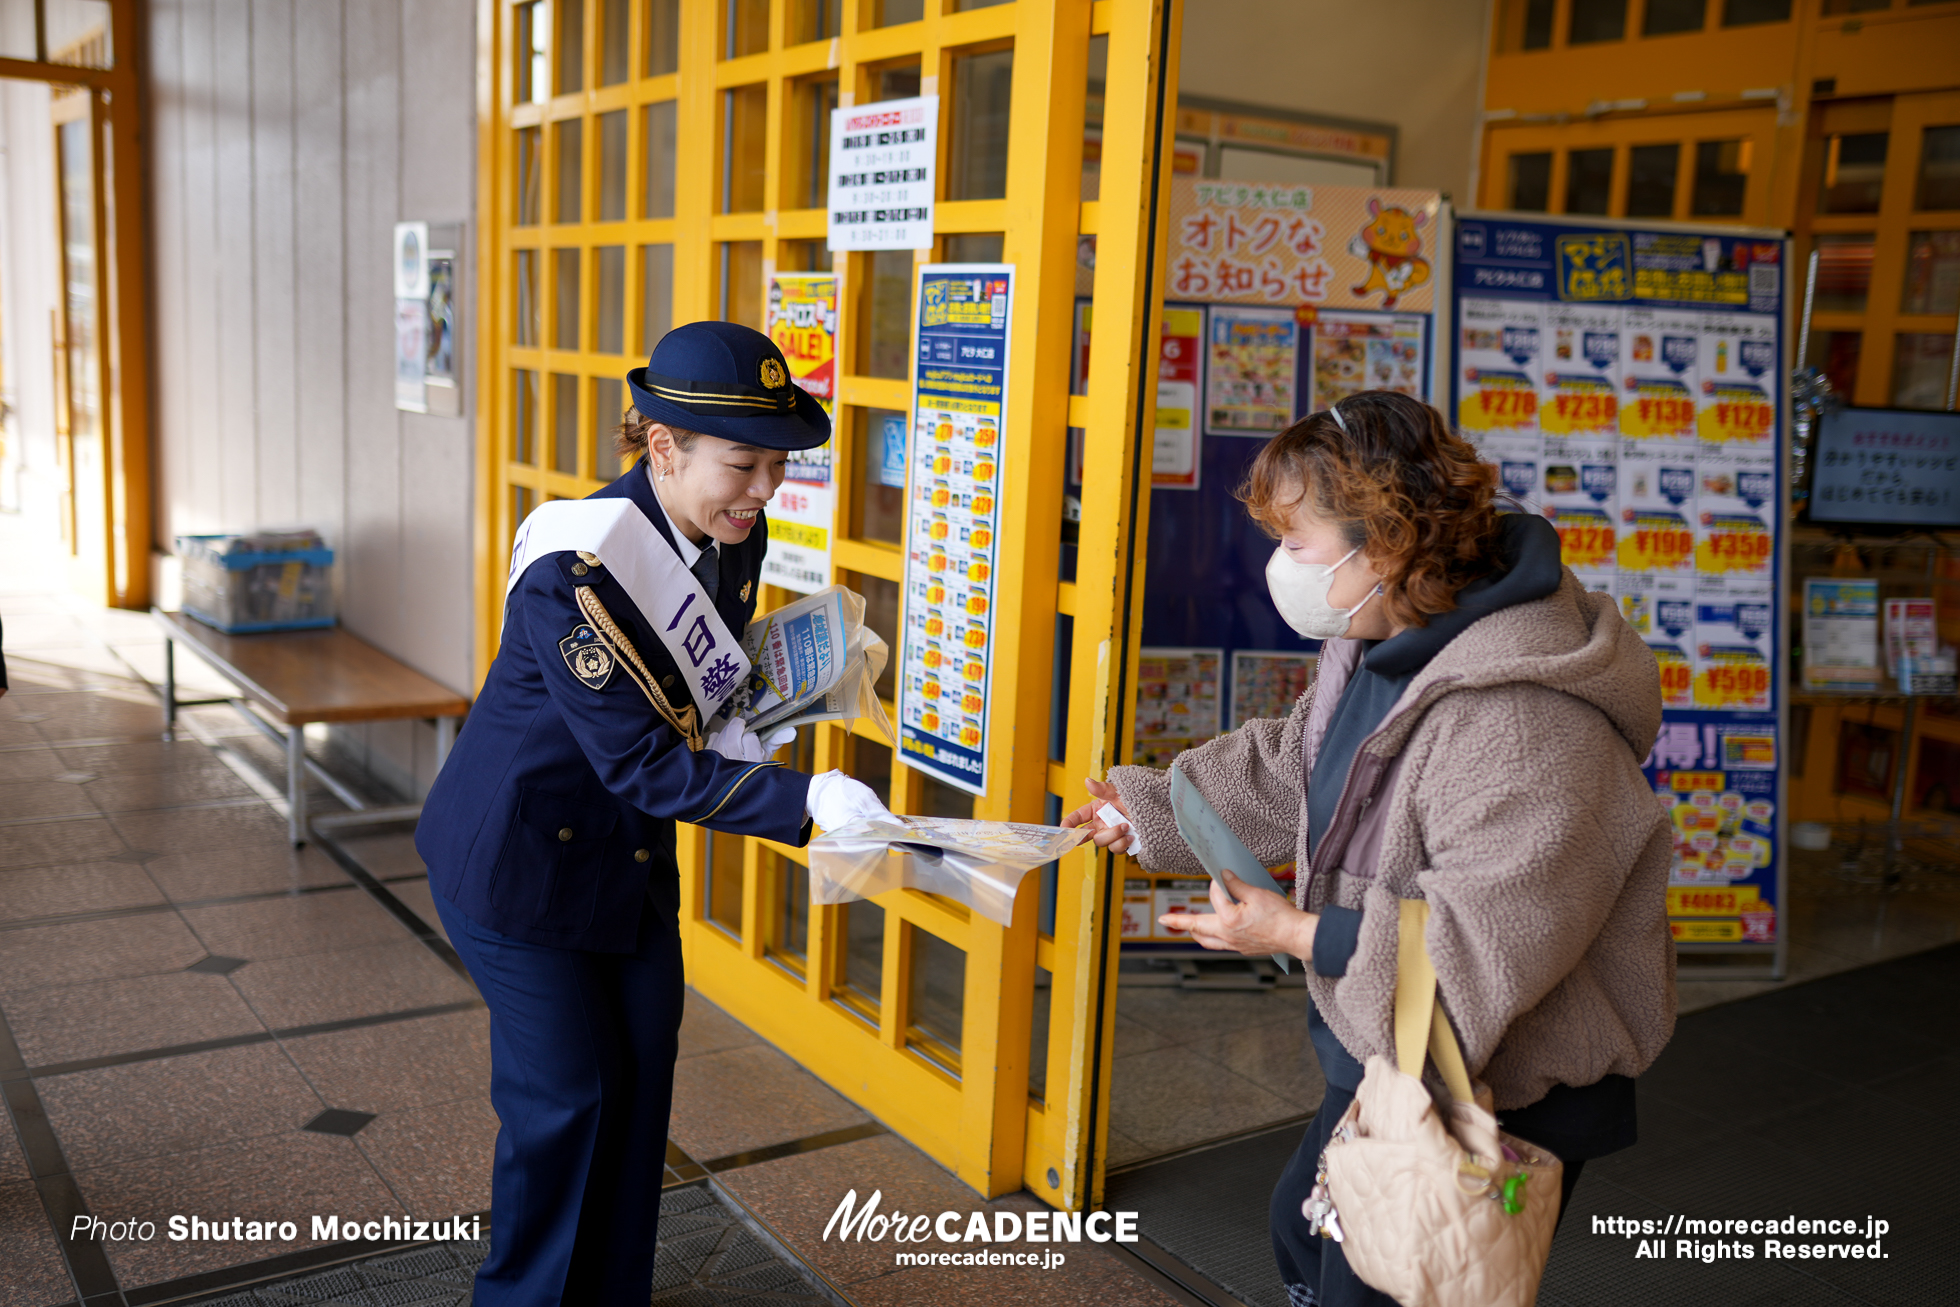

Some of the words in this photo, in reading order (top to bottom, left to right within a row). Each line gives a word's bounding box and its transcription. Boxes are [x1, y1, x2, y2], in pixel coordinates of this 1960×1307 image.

[1197, 186, 1311, 209] アピタ大仁店
[1184, 213, 1323, 255] オトクな
[1175, 257, 1331, 299] お知らせ
[1481, 389, 1538, 417] ¥278
[1555, 394, 1617, 420] ¥238
[1638, 398, 1695, 424] ¥138
[1716, 402, 1773, 428] ¥128
[1635, 530, 1692, 555] ¥198
[1709, 532, 1771, 556] ¥358
[666, 592, 740, 702] 一日警
[1707, 666, 1769, 692] ¥598
